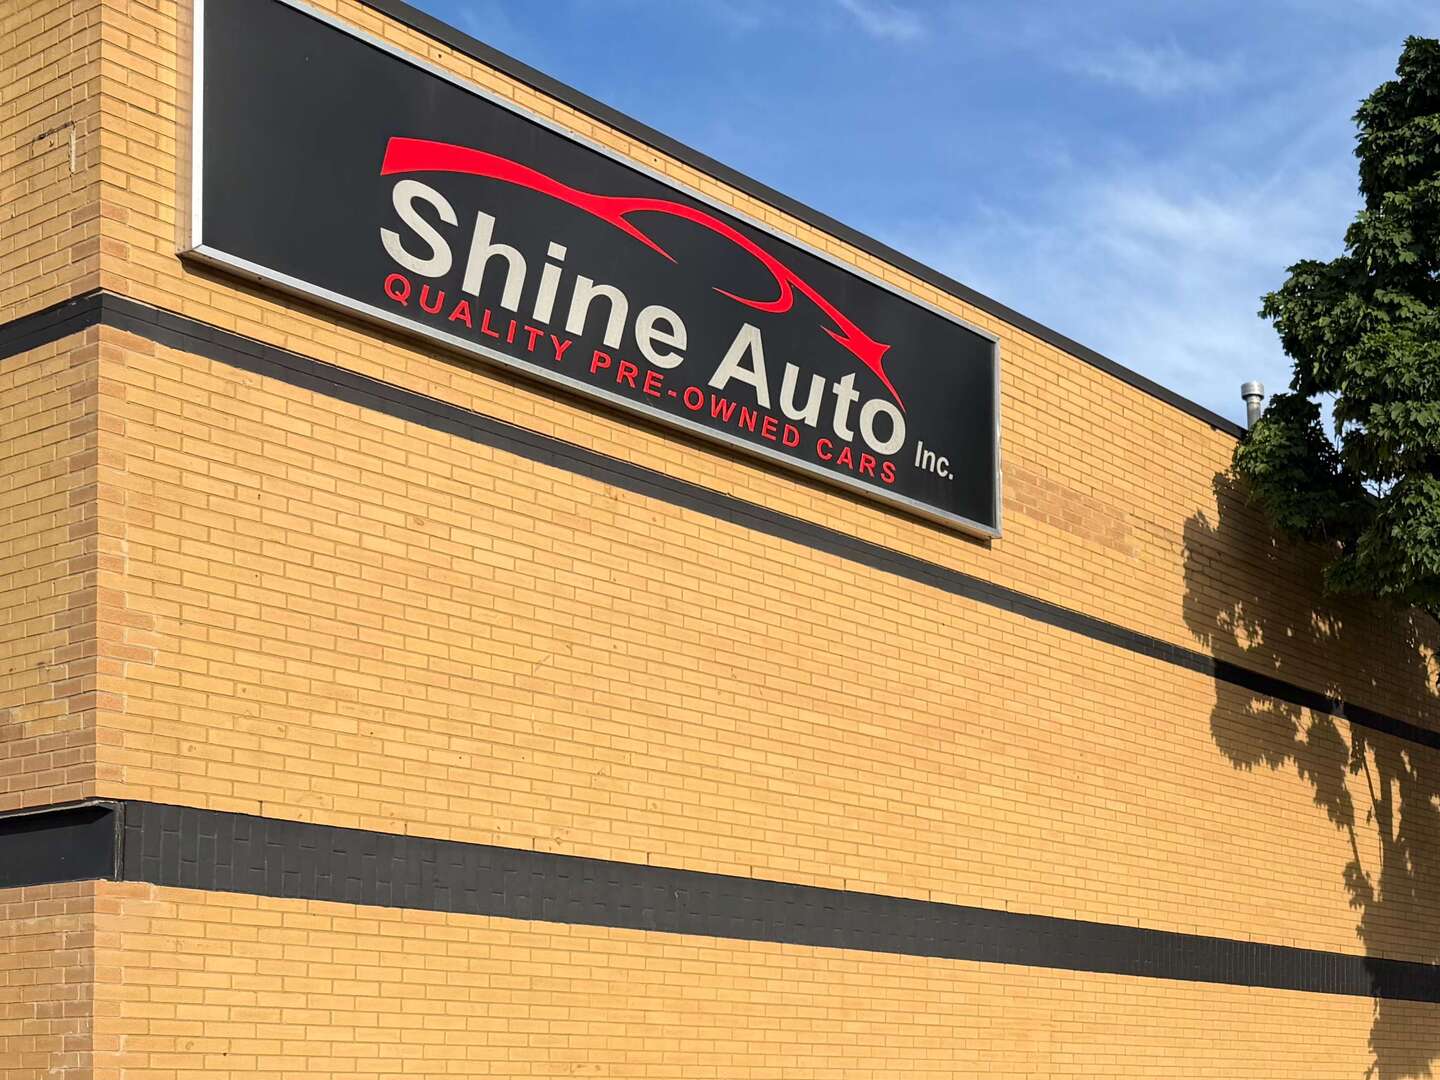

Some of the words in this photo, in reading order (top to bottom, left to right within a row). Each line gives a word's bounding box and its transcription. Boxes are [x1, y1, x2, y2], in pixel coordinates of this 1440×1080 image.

[380, 180, 688, 369] Shine
[708, 323, 907, 457] Auto
[914, 440, 955, 480] Inc.
[384, 274, 573, 361] QUALITY
[591, 351, 800, 448] PRE-OWNED
[817, 437, 896, 484] CARS
